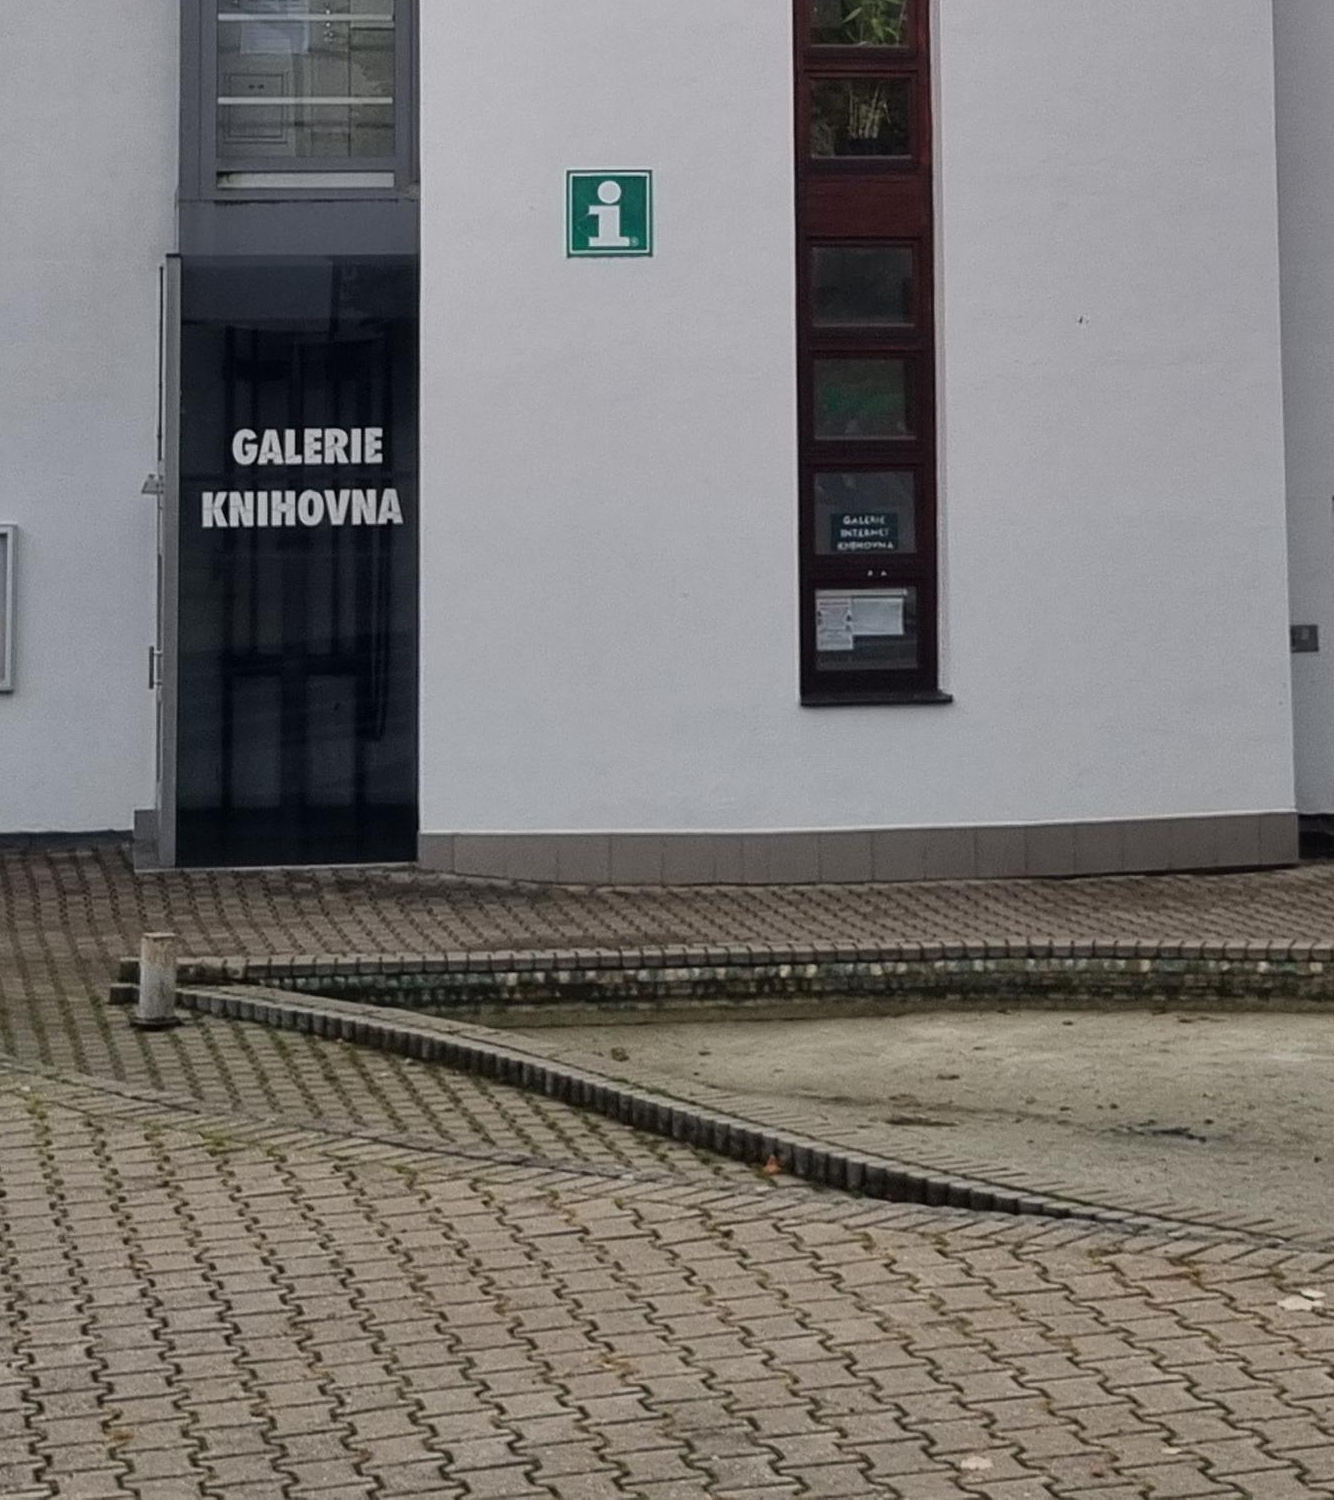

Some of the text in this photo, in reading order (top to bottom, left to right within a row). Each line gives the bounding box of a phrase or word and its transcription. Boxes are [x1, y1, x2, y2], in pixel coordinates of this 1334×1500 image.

[232, 427, 383, 466] GALERIE
[202, 488, 404, 528] KNIHOVNA
[842, 515, 885, 525] GALERIE
